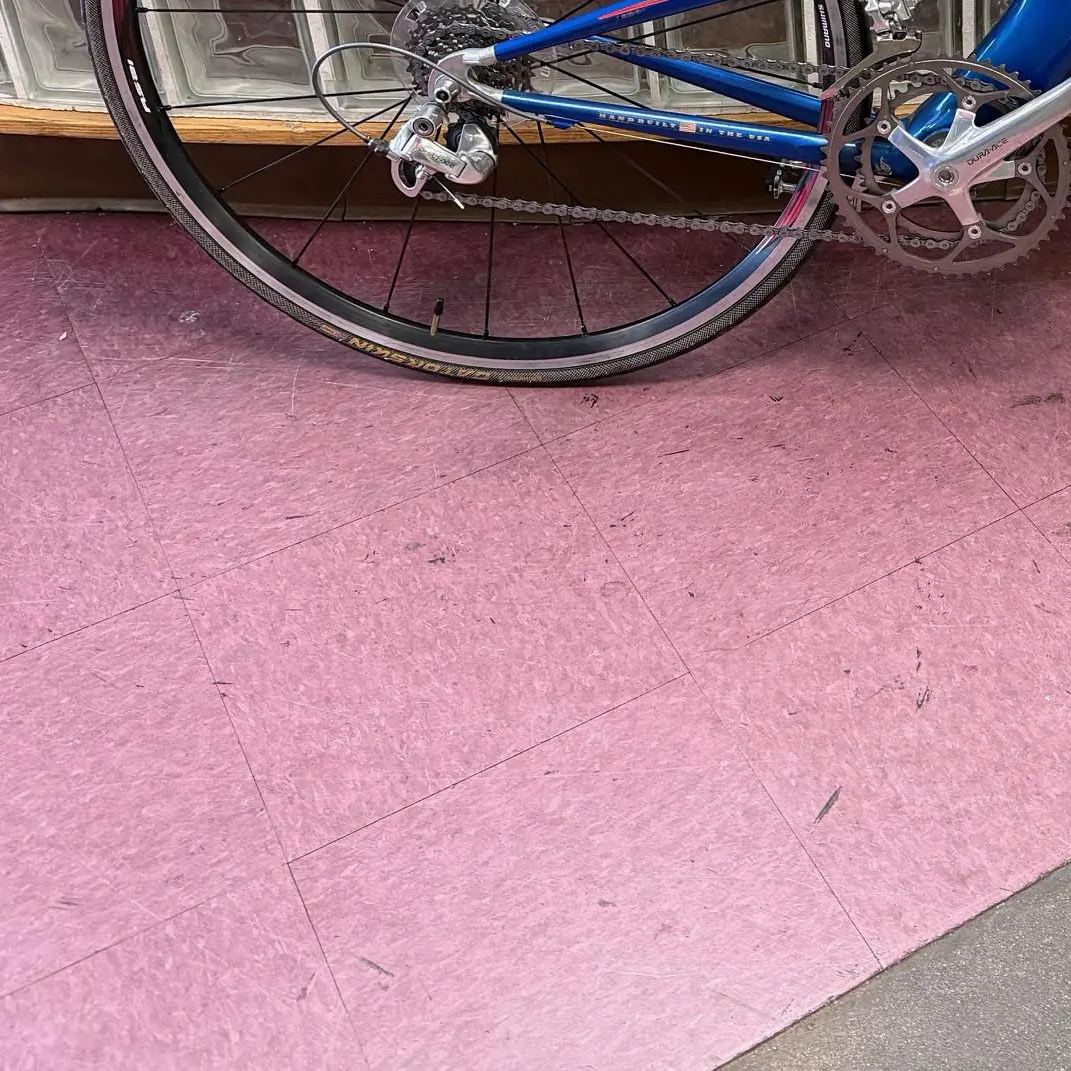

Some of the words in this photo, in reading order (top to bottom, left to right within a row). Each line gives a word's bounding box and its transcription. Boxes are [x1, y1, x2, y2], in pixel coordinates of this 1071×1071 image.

[597, 112, 677, 130] HANDBUILT
[699, 126, 713, 135] IN
[718, 129, 743, 139] THE
[748, 134, 772, 143] USA
